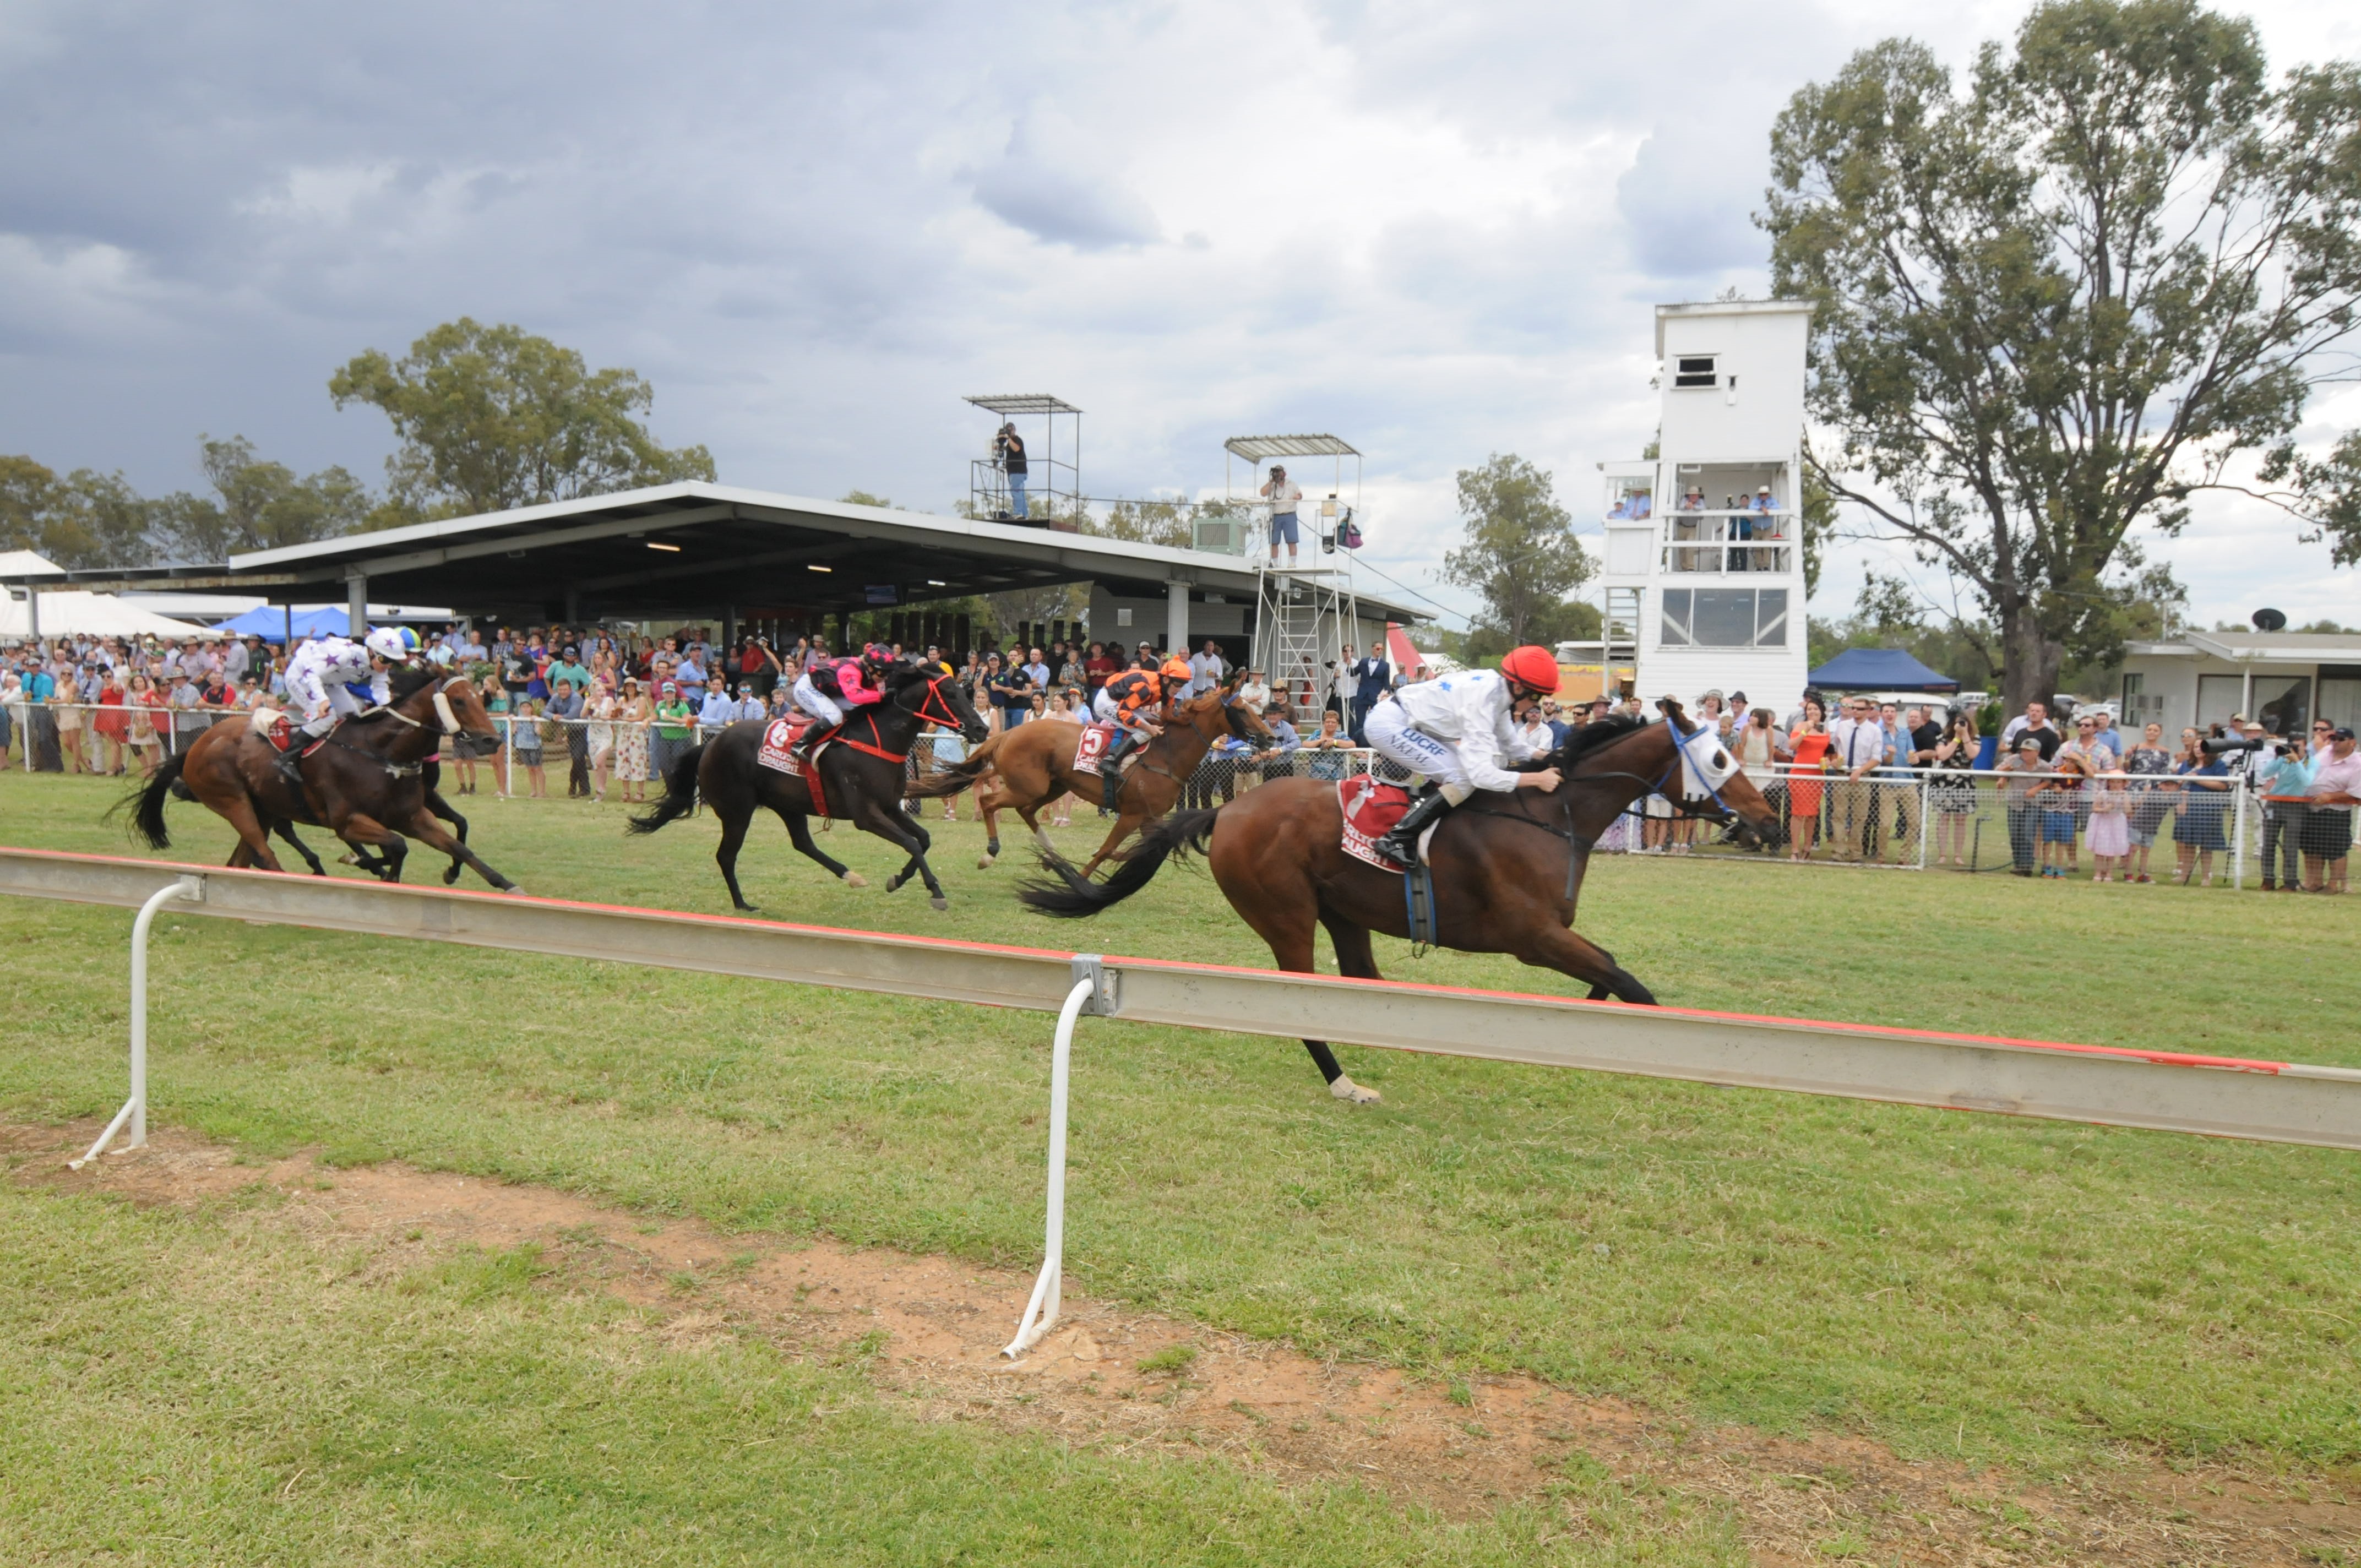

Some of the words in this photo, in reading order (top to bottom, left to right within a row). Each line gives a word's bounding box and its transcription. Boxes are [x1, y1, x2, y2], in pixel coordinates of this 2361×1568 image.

[770, 721, 793, 747] 6
[1084, 728, 1104, 754] 5
[1402, 728, 1448, 755] LUCRF
[760, 753, 799, 773] DRAUGHT
